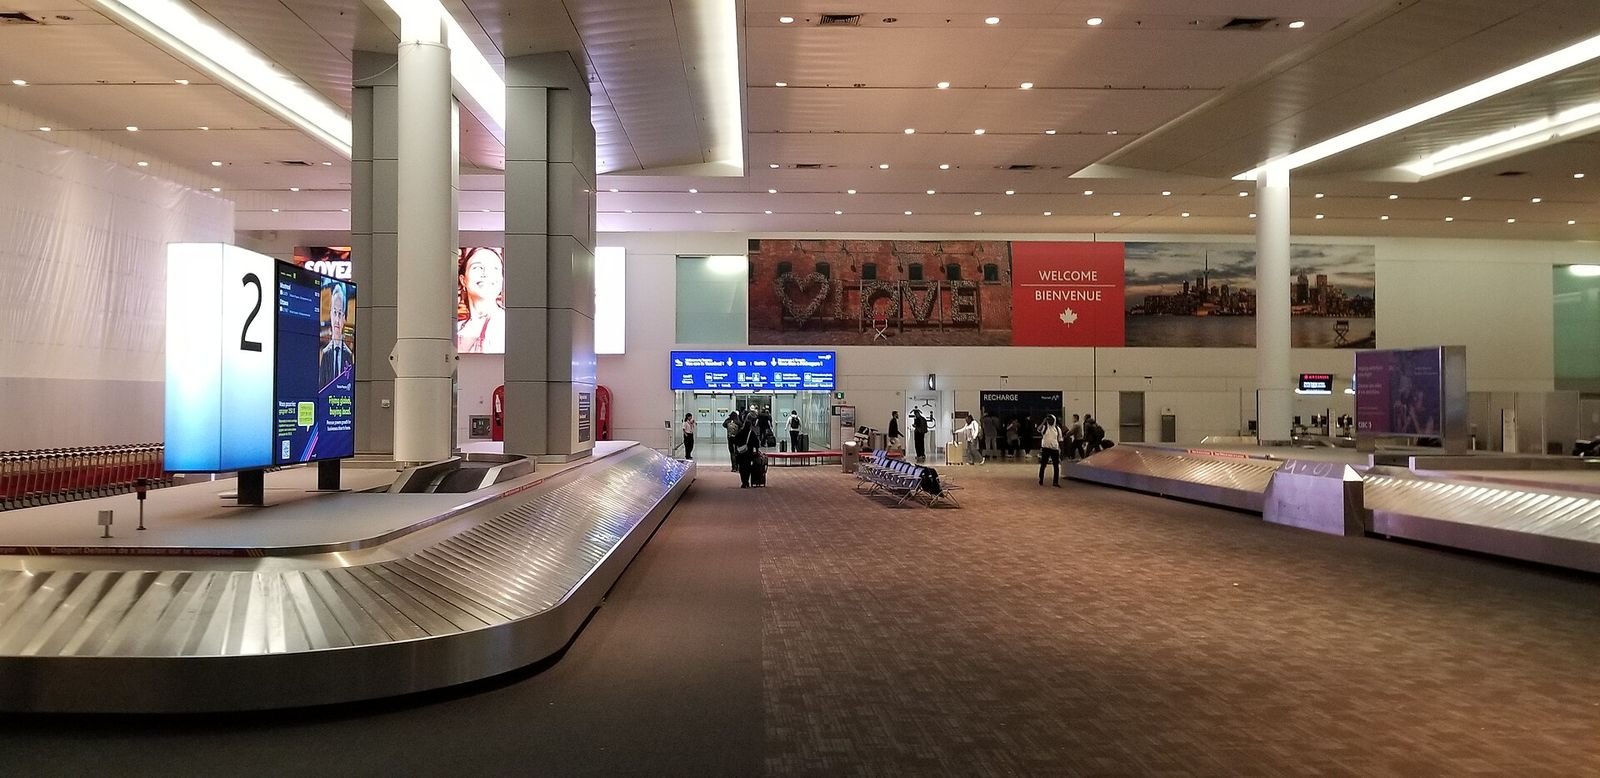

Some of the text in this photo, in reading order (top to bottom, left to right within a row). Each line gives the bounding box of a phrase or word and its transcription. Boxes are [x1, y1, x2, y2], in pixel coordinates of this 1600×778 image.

[304, 260, 352, 278] SOYEZ
[1038, 270, 1098, 281] WELCOME
[1034, 290, 1102, 301] BIENVENUE
[240, 272, 262, 352] 2
